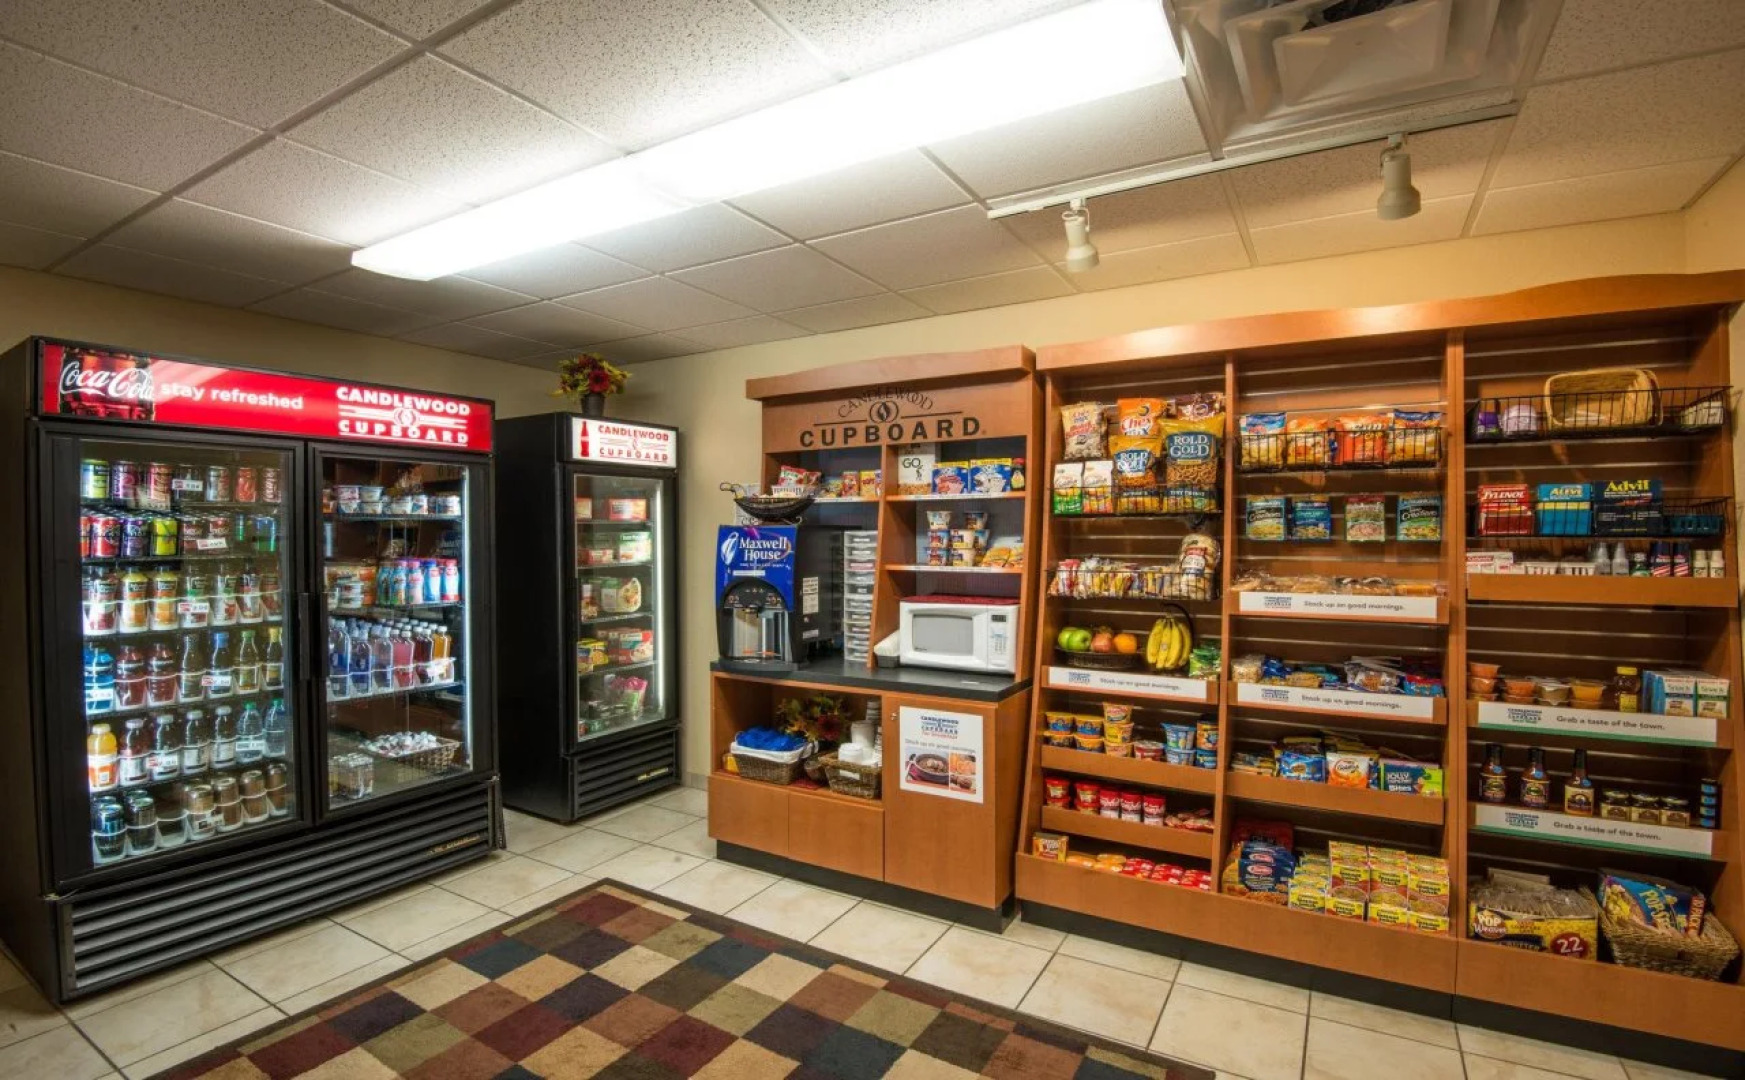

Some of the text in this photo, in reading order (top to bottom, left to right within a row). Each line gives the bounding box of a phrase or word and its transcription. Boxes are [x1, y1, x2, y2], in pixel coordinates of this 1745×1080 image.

[160, 383, 304, 409] stay refreshed
[336, 386, 470, 416] CANDLEWOOD
[838, 386, 934, 418] CANDLEWOOD
[338, 419, 468, 443] CUPBOARD
[598, 425, 669, 441] CANDLEWOOD
[800, 416, 981, 448] CUPBOARD
[1173, 434, 1208, 445] ROLD
[599, 446, 668, 461] CUPBOARD
[1170, 444, 1210, 457] GOLD
[1605, 479, 1650, 492] Advil
[1484, 491, 1524, 499] TYLENOL
[739, 536, 787, 549] Maxwell
[744, 549, 781, 561] House
[1347, 602, 1367, 610] good
[1556, 715, 1578, 724] Grab
[1587, 718, 1609, 726] taste
[1623, 720, 1637, 728] the
[1553, 821, 1575, 829] Grab
[1583, 825, 1605, 833] taste
[1619, 829, 1633, 837] the
[1636, 832, 1662, 840] town.
[1556, 936, 1584, 954] 22
